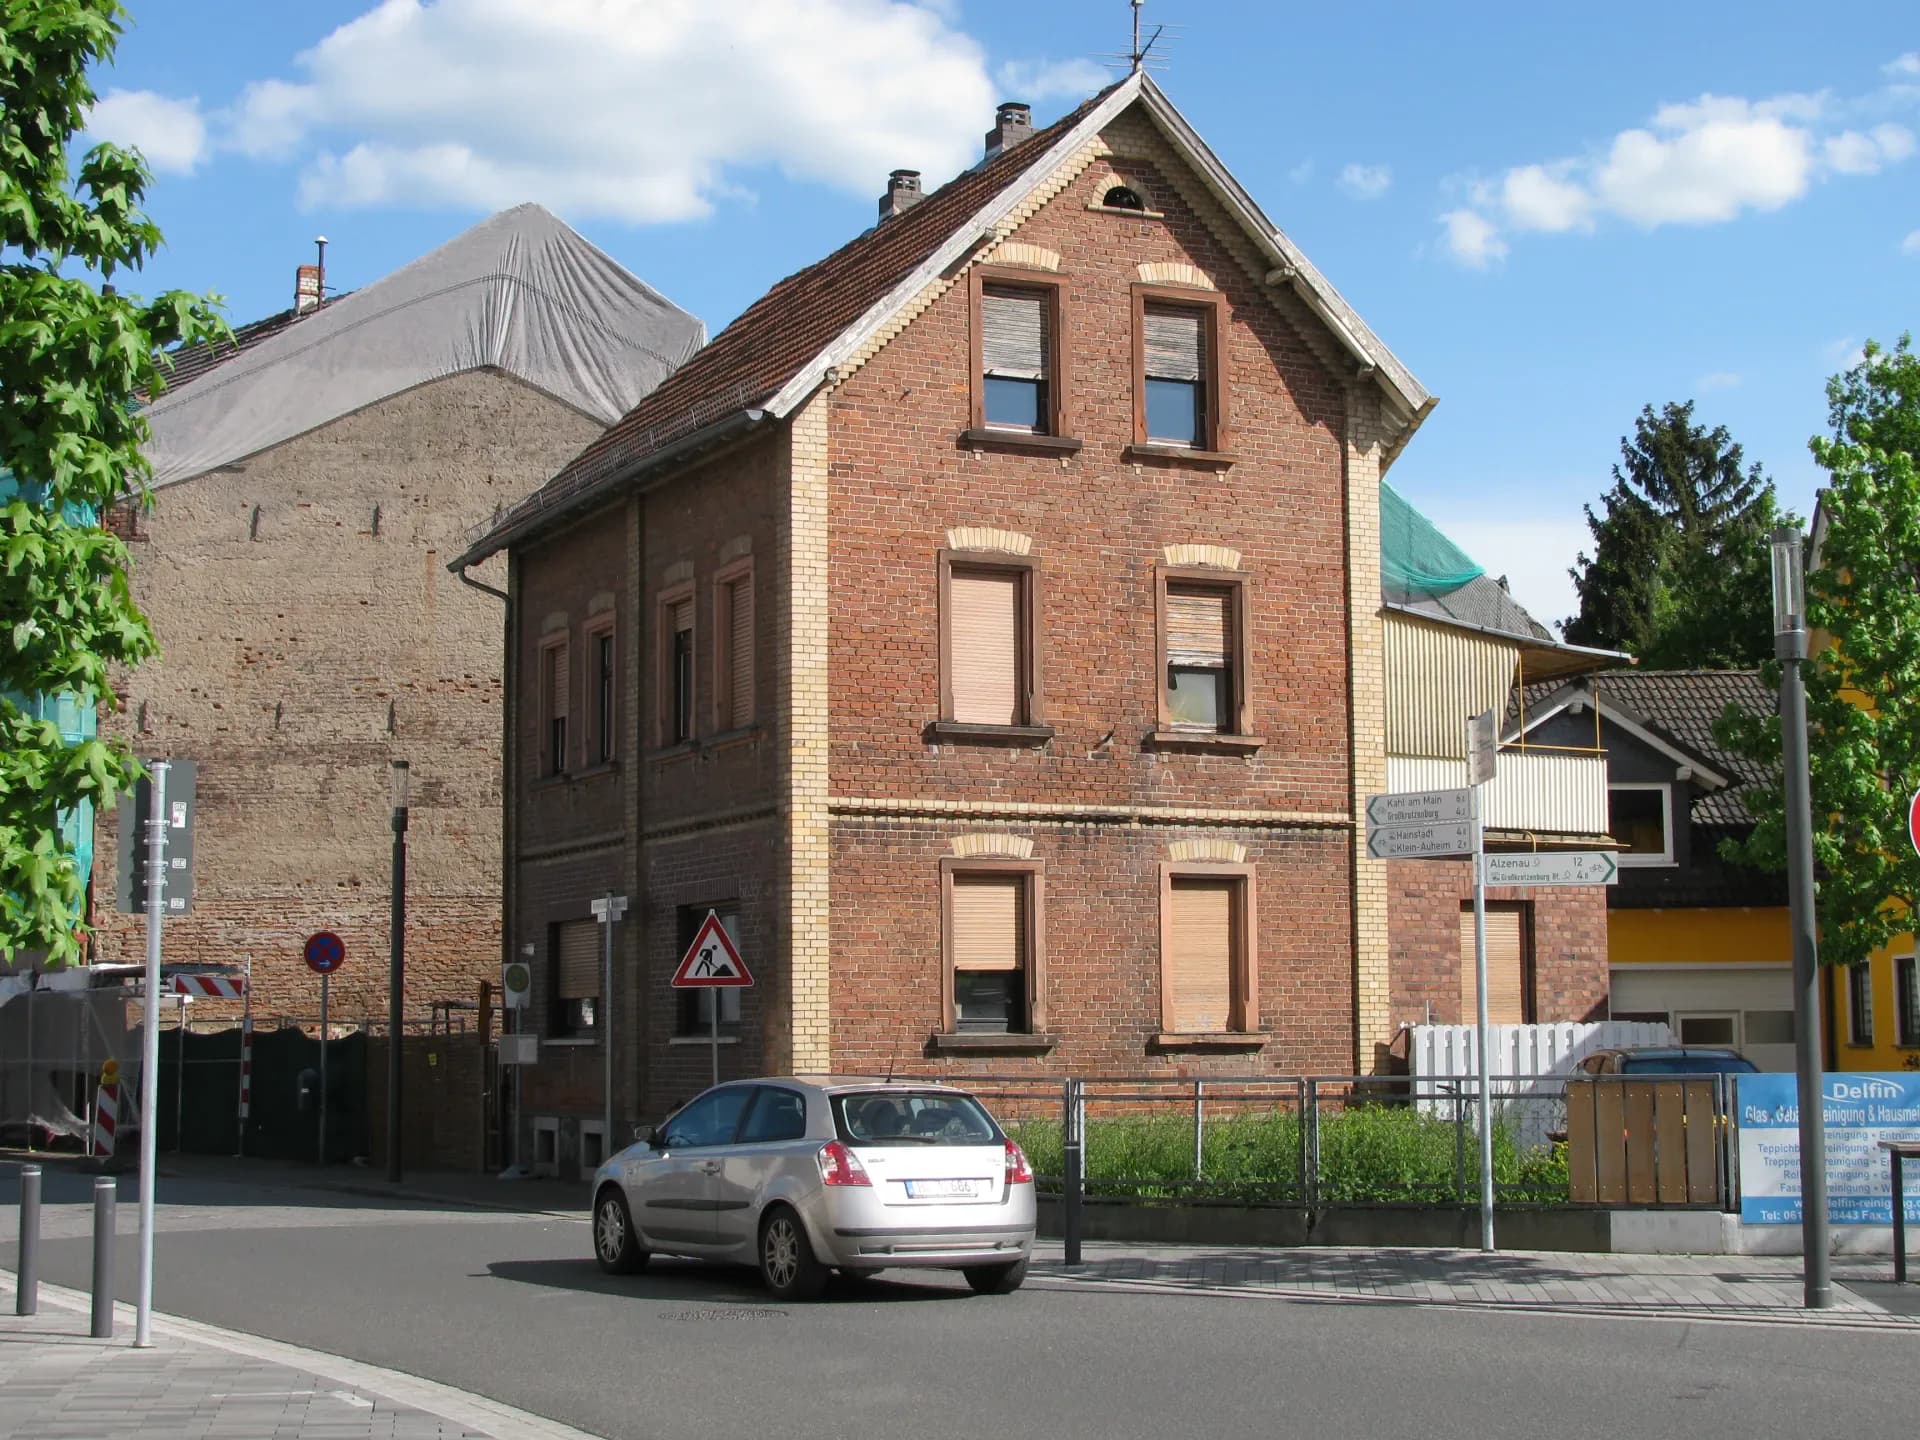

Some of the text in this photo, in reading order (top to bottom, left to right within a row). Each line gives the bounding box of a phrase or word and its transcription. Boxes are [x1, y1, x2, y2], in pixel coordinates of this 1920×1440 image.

[1387, 798, 1405, 808] Kahl
[1407, 798, 1420, 807] am
[1423, 796, 1442, 806] Main
[1396, 829, 1433, 840] Hainstadt
[1396, 841, 1451, 852] Klein-Auheim
[1490, 856, 1583, 868] Alzenau 12
[1833, 1082, 1897, 1099] Delfin
[1867, 1104, 1875, 1122] &
[1760, 1210, 1780, 1220] Tel:
[1861, 1211, 1887, 1220] Fax:
